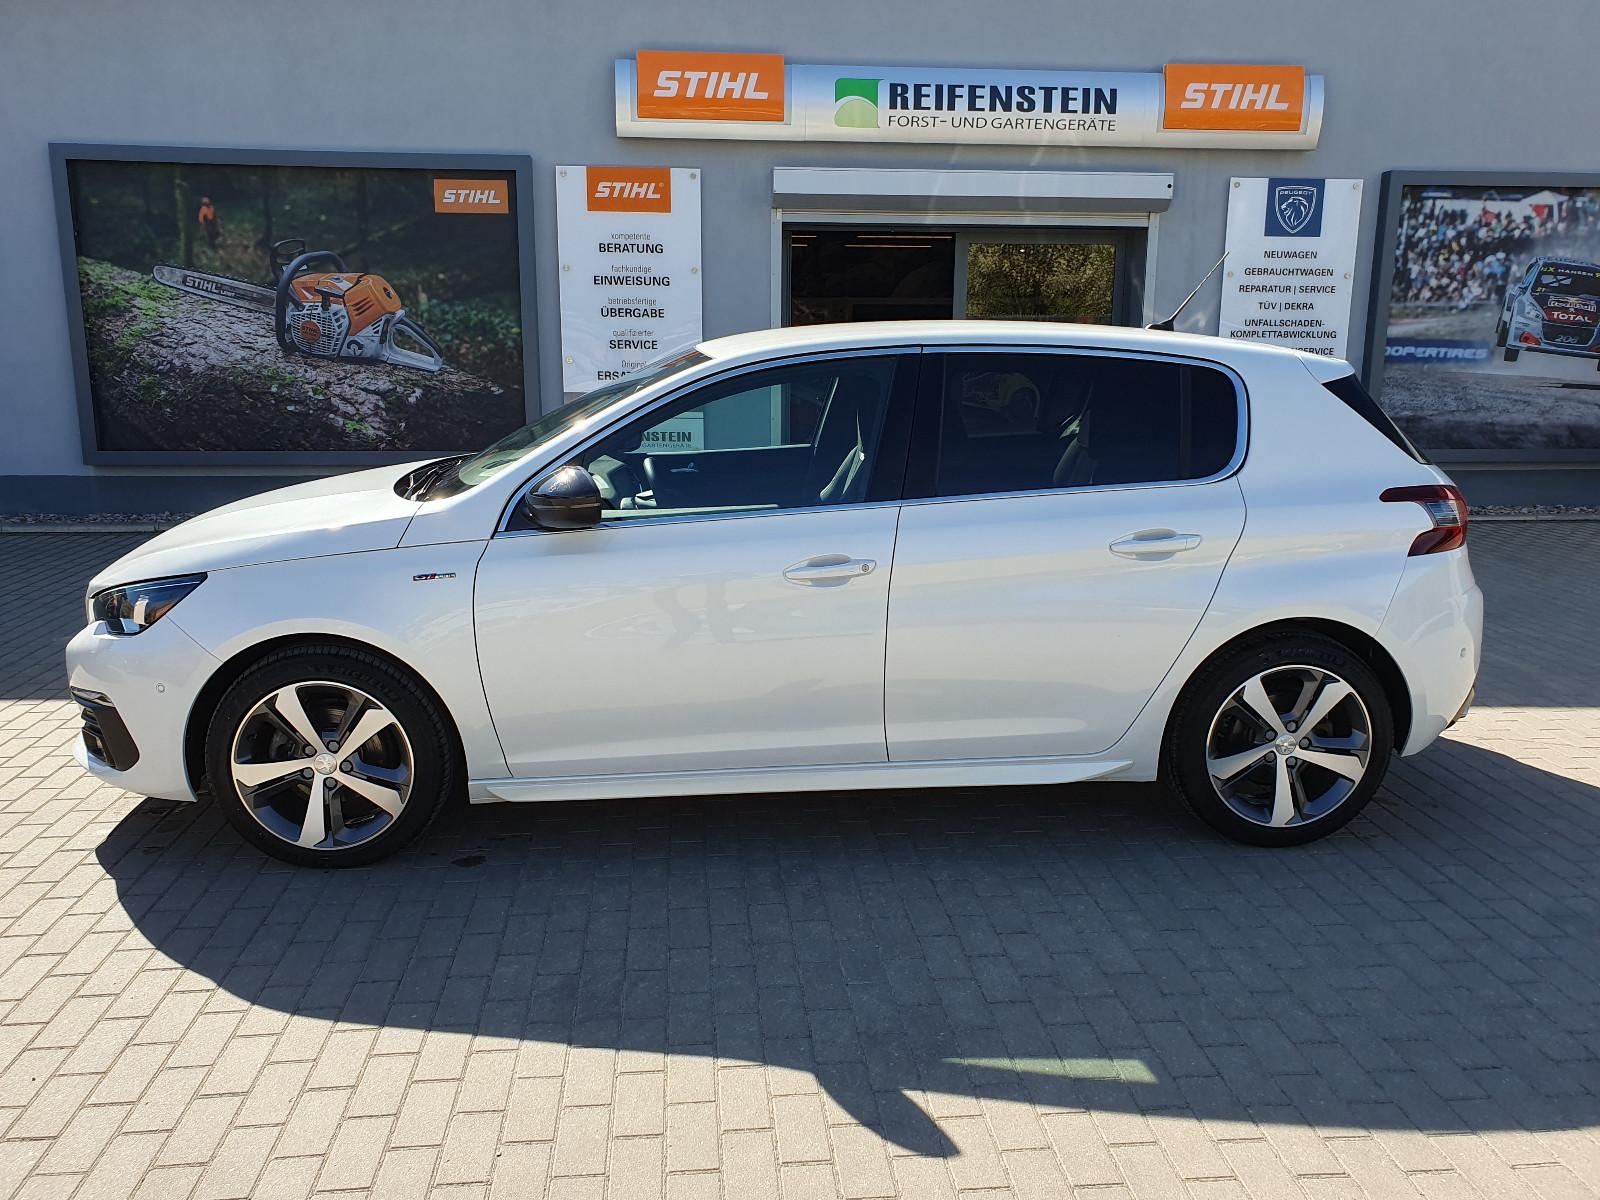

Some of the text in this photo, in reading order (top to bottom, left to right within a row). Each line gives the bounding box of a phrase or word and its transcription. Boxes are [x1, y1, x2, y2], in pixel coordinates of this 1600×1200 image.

[653, 70, 769, 100] STIHL
[888, 82, 1118, 115] REIFENSTEIN
[1180, 82, 1290, 111] STIHL
[887, 115, 1117, 132] FORST- UND GARTENGERÄTE
[595, 181, 661, 199] STIHL
[442, 189, 501, 205] STIHL
[610, 232, 651, 242] kompetente
[598, 243, 664, 254] BERATUNG
[1263, 250, 1318, 260] NEUWAGEN
[611, 264, 652, 275] fachkundige
[1244, 267, 1334, 277] GEBRAUCHTWAGEN
[185, 275, 221, 293] STIHL
[593, 275, 670, 287] EINWEISUNG
[1238, 285, 1292, 294] REPARATUR
[1298, 285, 1336, 294] SERVICE
[607, 296, 657, 306] betriebsfertige
[1258, 301, 1278, 311] TÜV
[1284, 302, 1314, 311] DEKRA
[600, 306, 665, 319] ÜBERGABE
[1551, 311, 1593, 323] TOTAL
[1244, 318, 1325, 328] UNFALLSCHADEN-
[1230, 330, 1337, 339] KOMPLETTABWICKLUNG
[609, 339, 658, 351] SERVICE
[640, 431, 692, 443] NSTEIN
